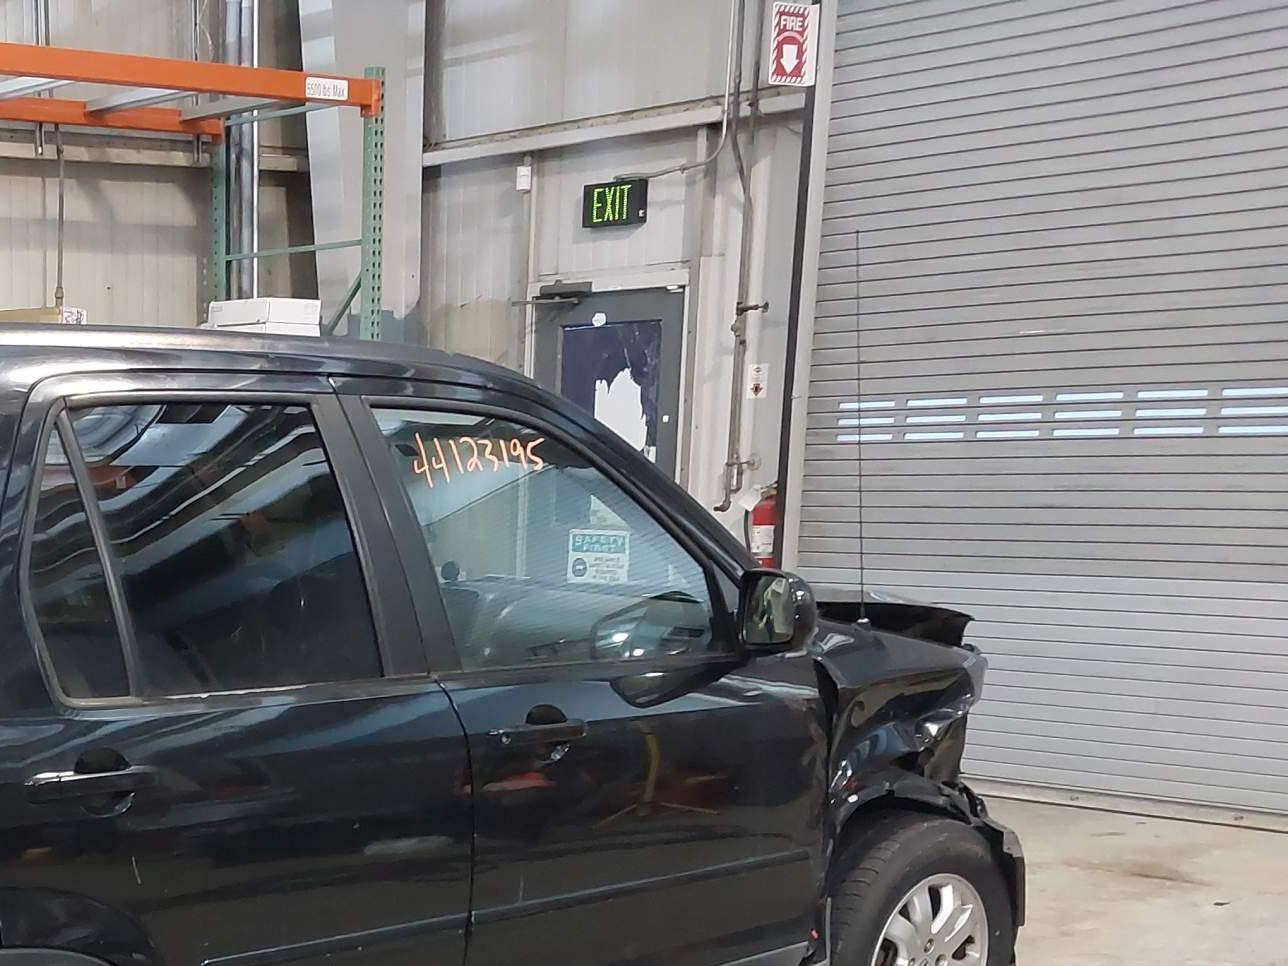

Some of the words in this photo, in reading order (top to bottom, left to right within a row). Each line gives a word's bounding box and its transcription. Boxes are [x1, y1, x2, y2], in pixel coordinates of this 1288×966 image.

[780, 15, 804, 31] FIRE
[593, 185, 632, 222] EXIT
[414, 432, 545, 488] 44123195
[575, 535, 624, 546] SAFETY
